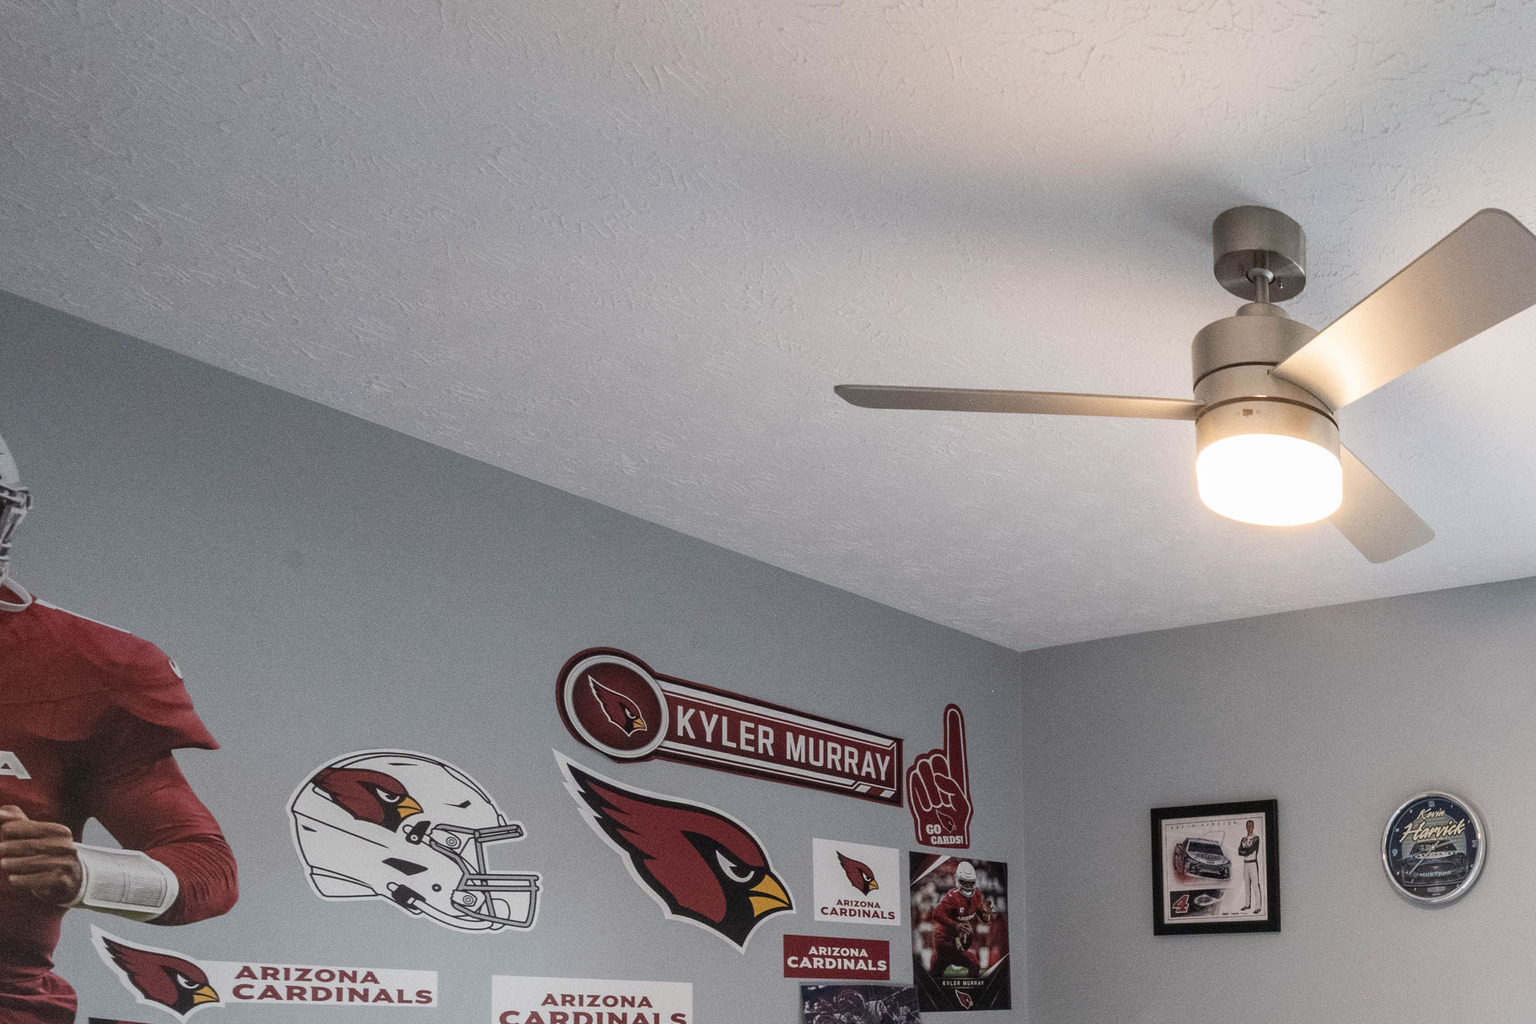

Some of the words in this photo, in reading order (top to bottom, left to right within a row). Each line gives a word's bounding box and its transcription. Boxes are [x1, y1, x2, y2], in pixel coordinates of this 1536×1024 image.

[677, 705, 774, 757] KYLER
[786, 731, 890, 782] MURRAY
[1416, 808, 1445, 820] Kevin
[925, 823, 942, 835] GO
[1399, 818, 1466, 843] Harvick
[930, 835, 964, 845] CARDS!
[836, 899, 881, 909] ARIZONA
[1172, 894, 1190, 914] 4
[820, 906, 896, 920] CARDINALS
[808, 946, 868, 957] ARIZONA
[787, 956, 887, 971] CARDINALS
[234, 965, 381, 985] ARIZONA
[232, 983, 434, 1005] CARDINALS
[541, 993, 654, 1009] ARIZONA
